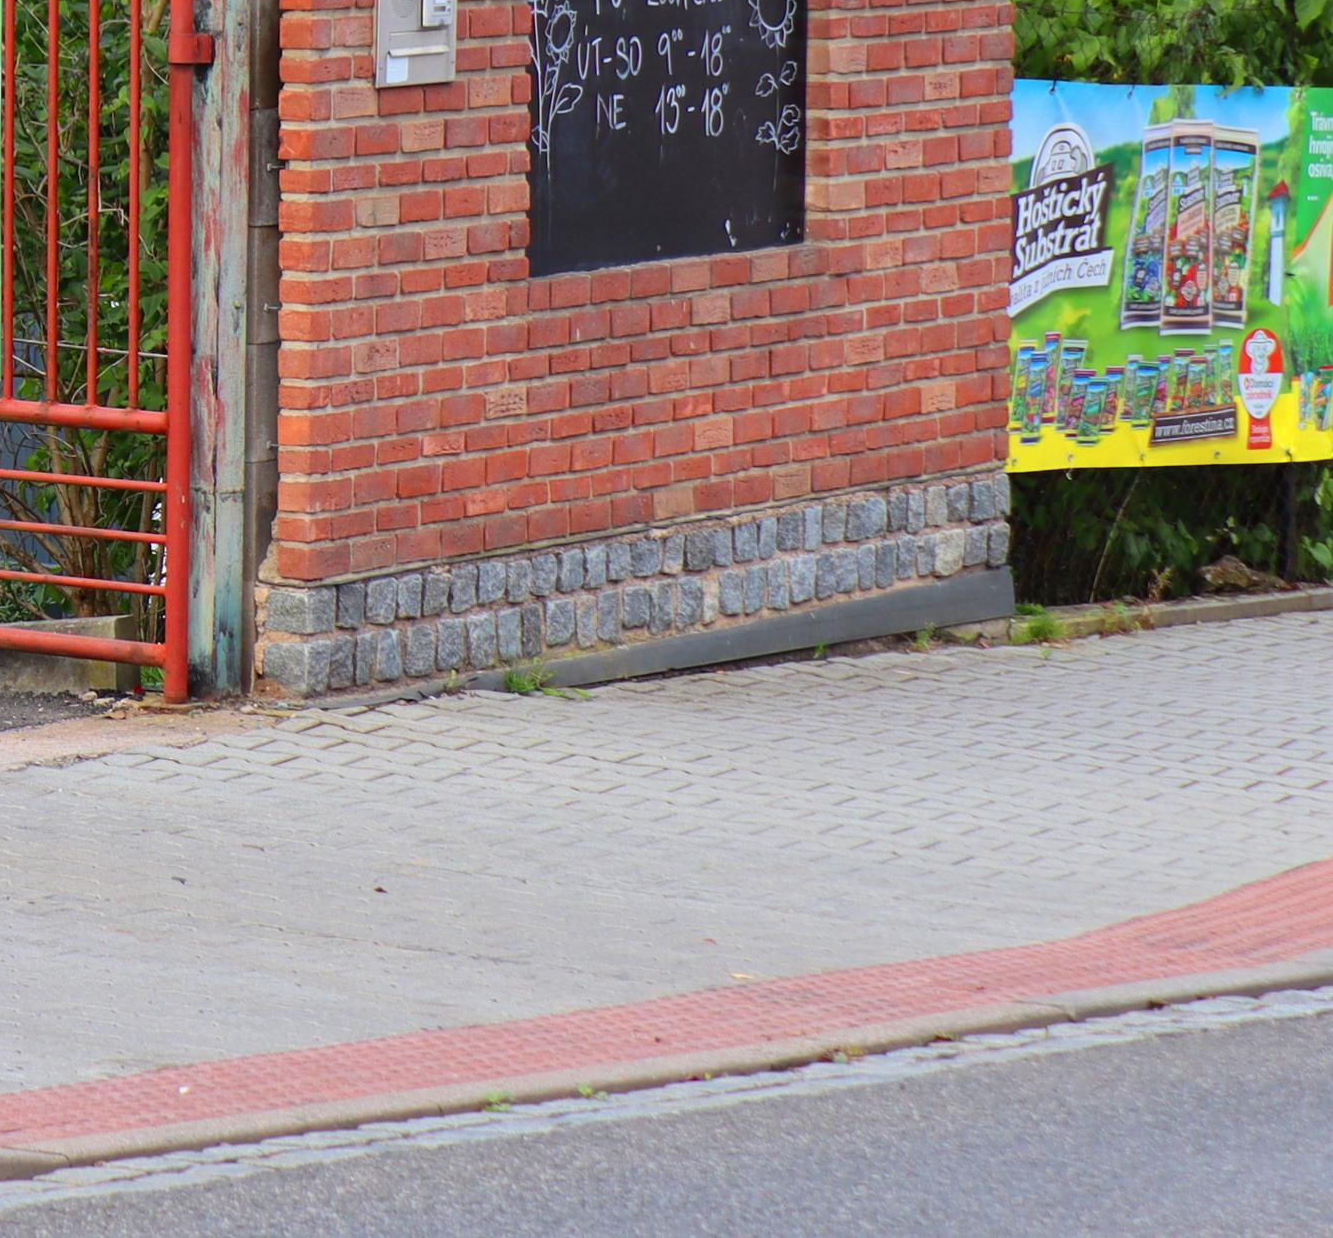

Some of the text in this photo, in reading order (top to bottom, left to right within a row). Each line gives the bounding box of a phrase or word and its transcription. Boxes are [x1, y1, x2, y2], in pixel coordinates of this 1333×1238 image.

[597, 93, 627, 130] NE
[1016, 172, 1107, 237] Hoštický
[1013, 213, 1101, 279] Substrát
[1077, 257, 1107, 280] Čech
[1155, 417, 1235, 438] www.forestina.cz
